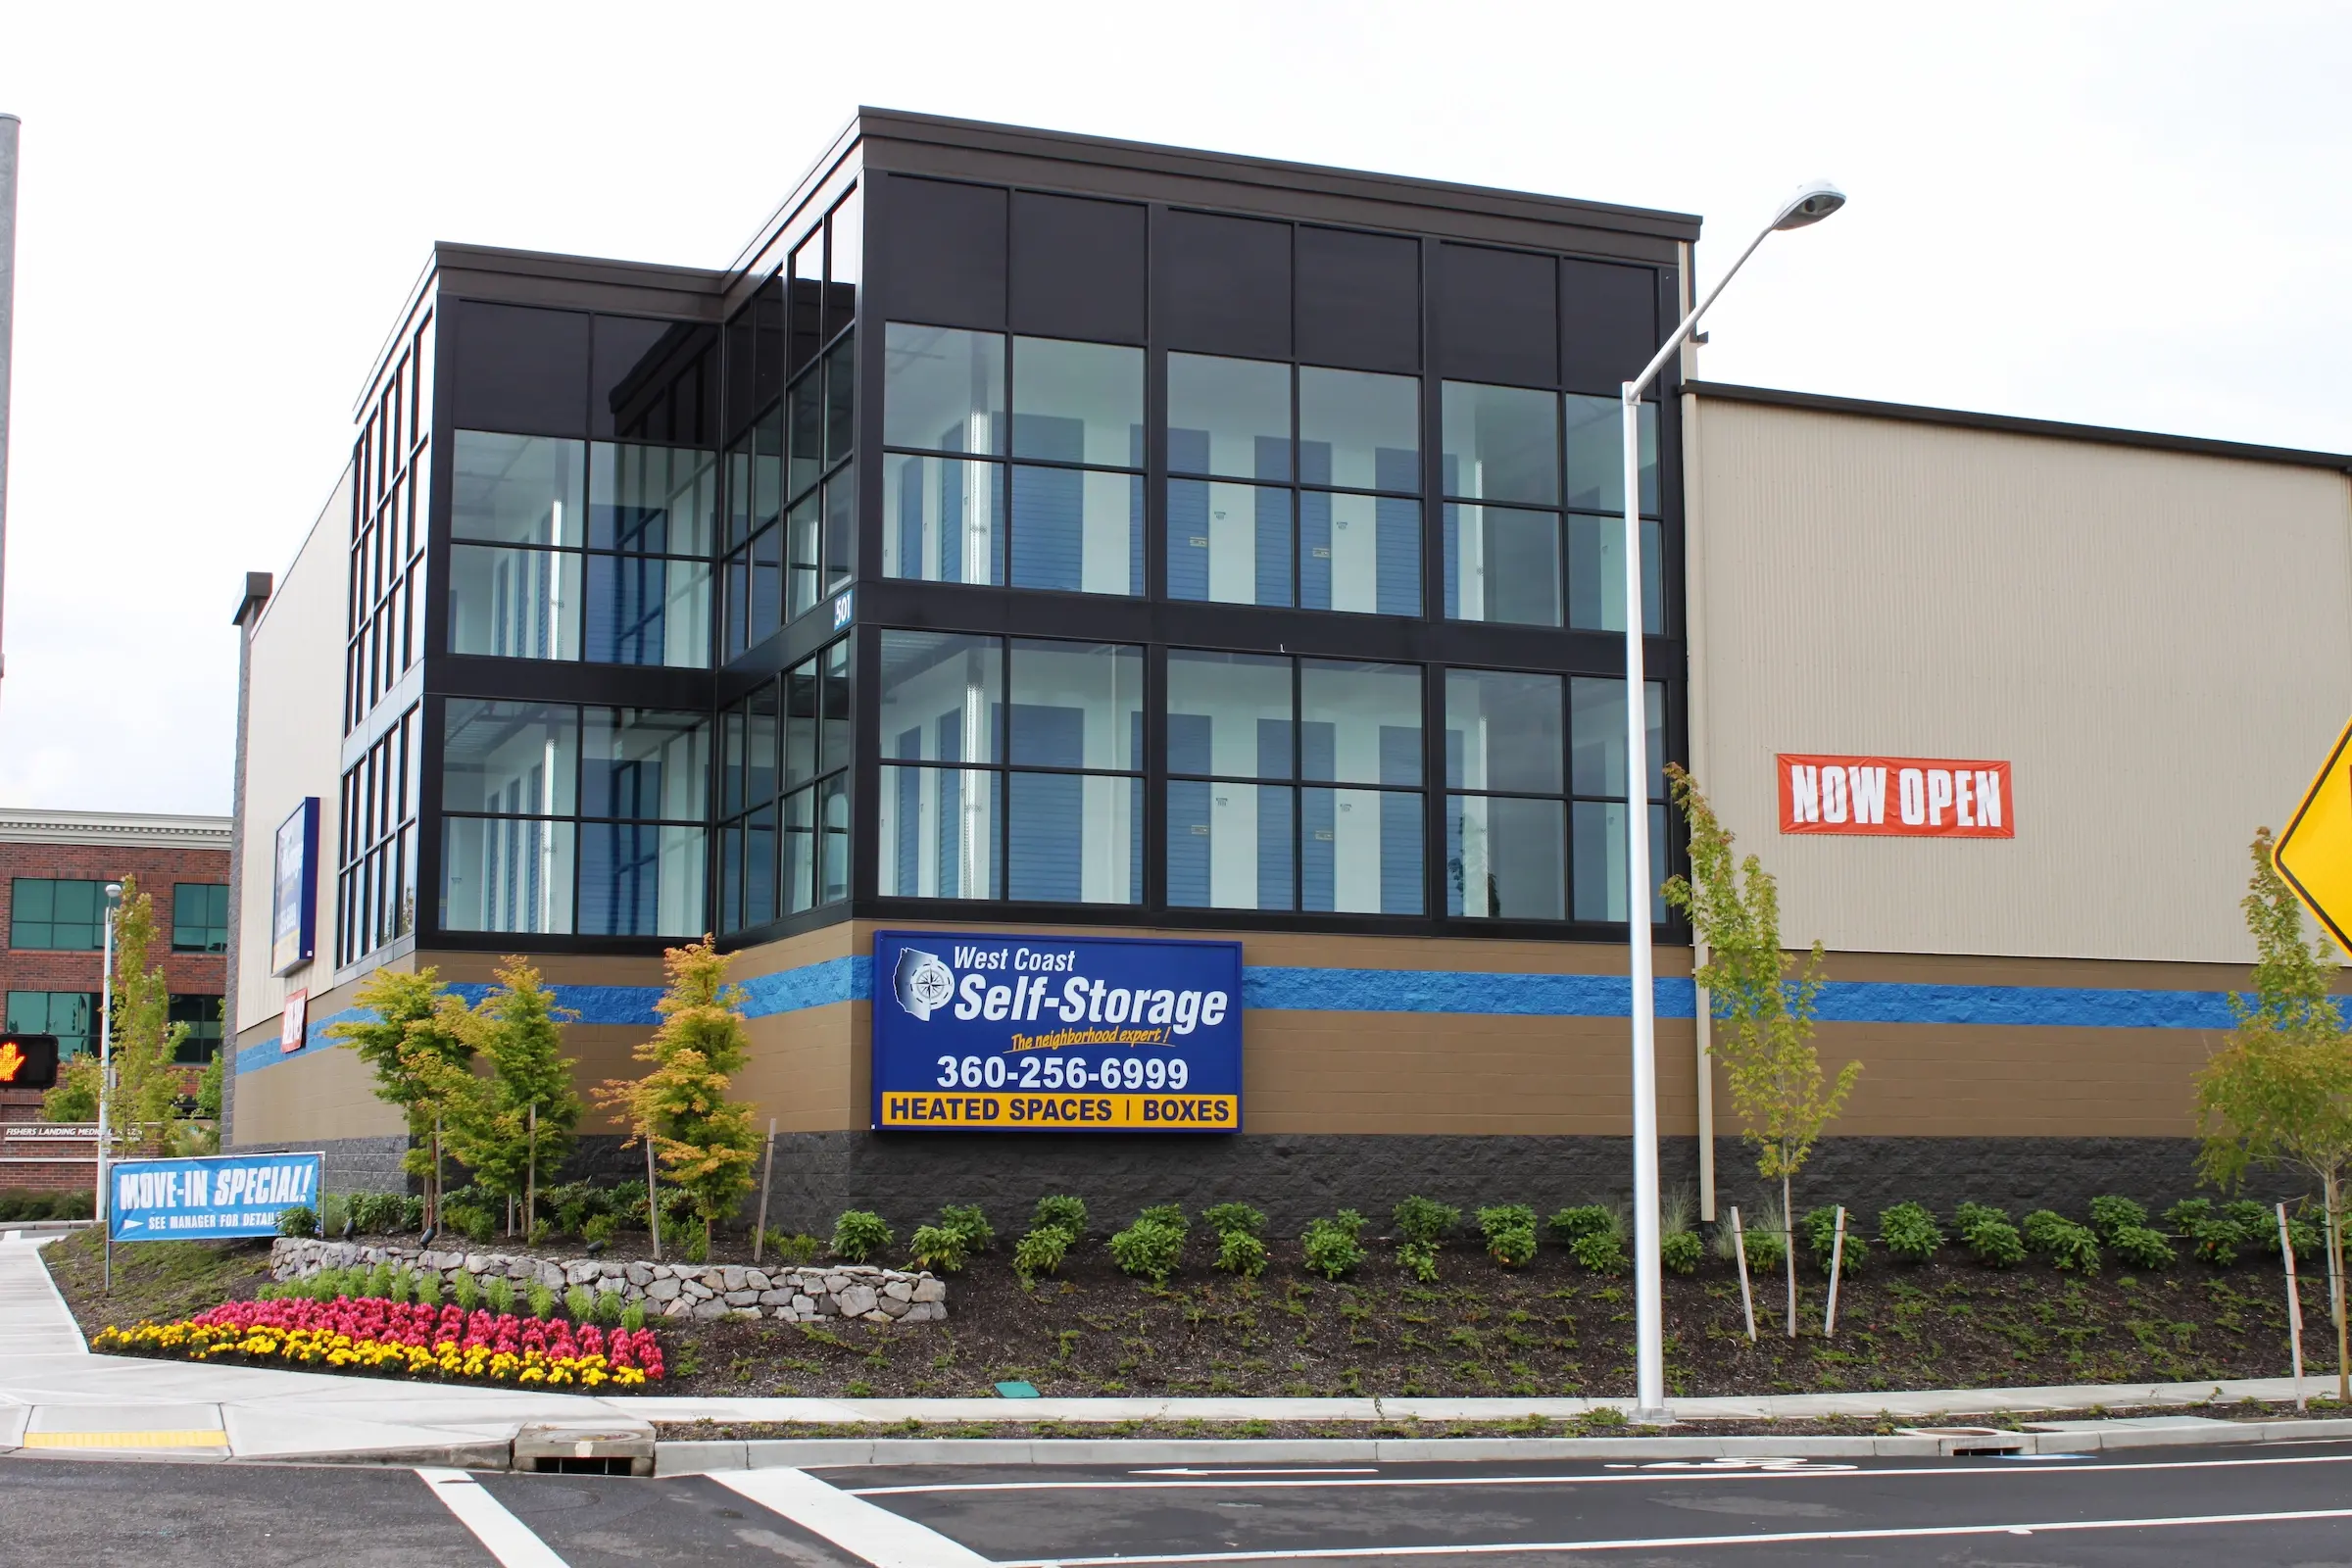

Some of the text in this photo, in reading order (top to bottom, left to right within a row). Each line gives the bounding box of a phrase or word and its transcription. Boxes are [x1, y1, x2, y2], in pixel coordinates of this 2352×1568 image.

[836, 594, 851, 626] 501
[1791, 764, 2002, 827] NOW OPEN
[954, 946, 1076, 972] West Coast
[954, 973, 1229, 1035] Self-Storage
[1011, 1033, 1037, 1052] The
[1035, 1026, 1119, 1051] neighborhood
[1119, 1028, 1161, 1048] expert
[936, 1055, 1189, 1090] 360-256-6999
[890, 1098, 1001, 1121] HEATED
[1008, 1099, 1112, 1121] SPACES
[1143, 1100, 1230, 1122] BOXES
[120, 1165, 314, 1210] MOVE-IN SPECIAL!
[148, 1216, 166, 1231] SEE
[170, 1214, 217, 1229] MANAGER
[220, 1213, 239, 1227] FOR
